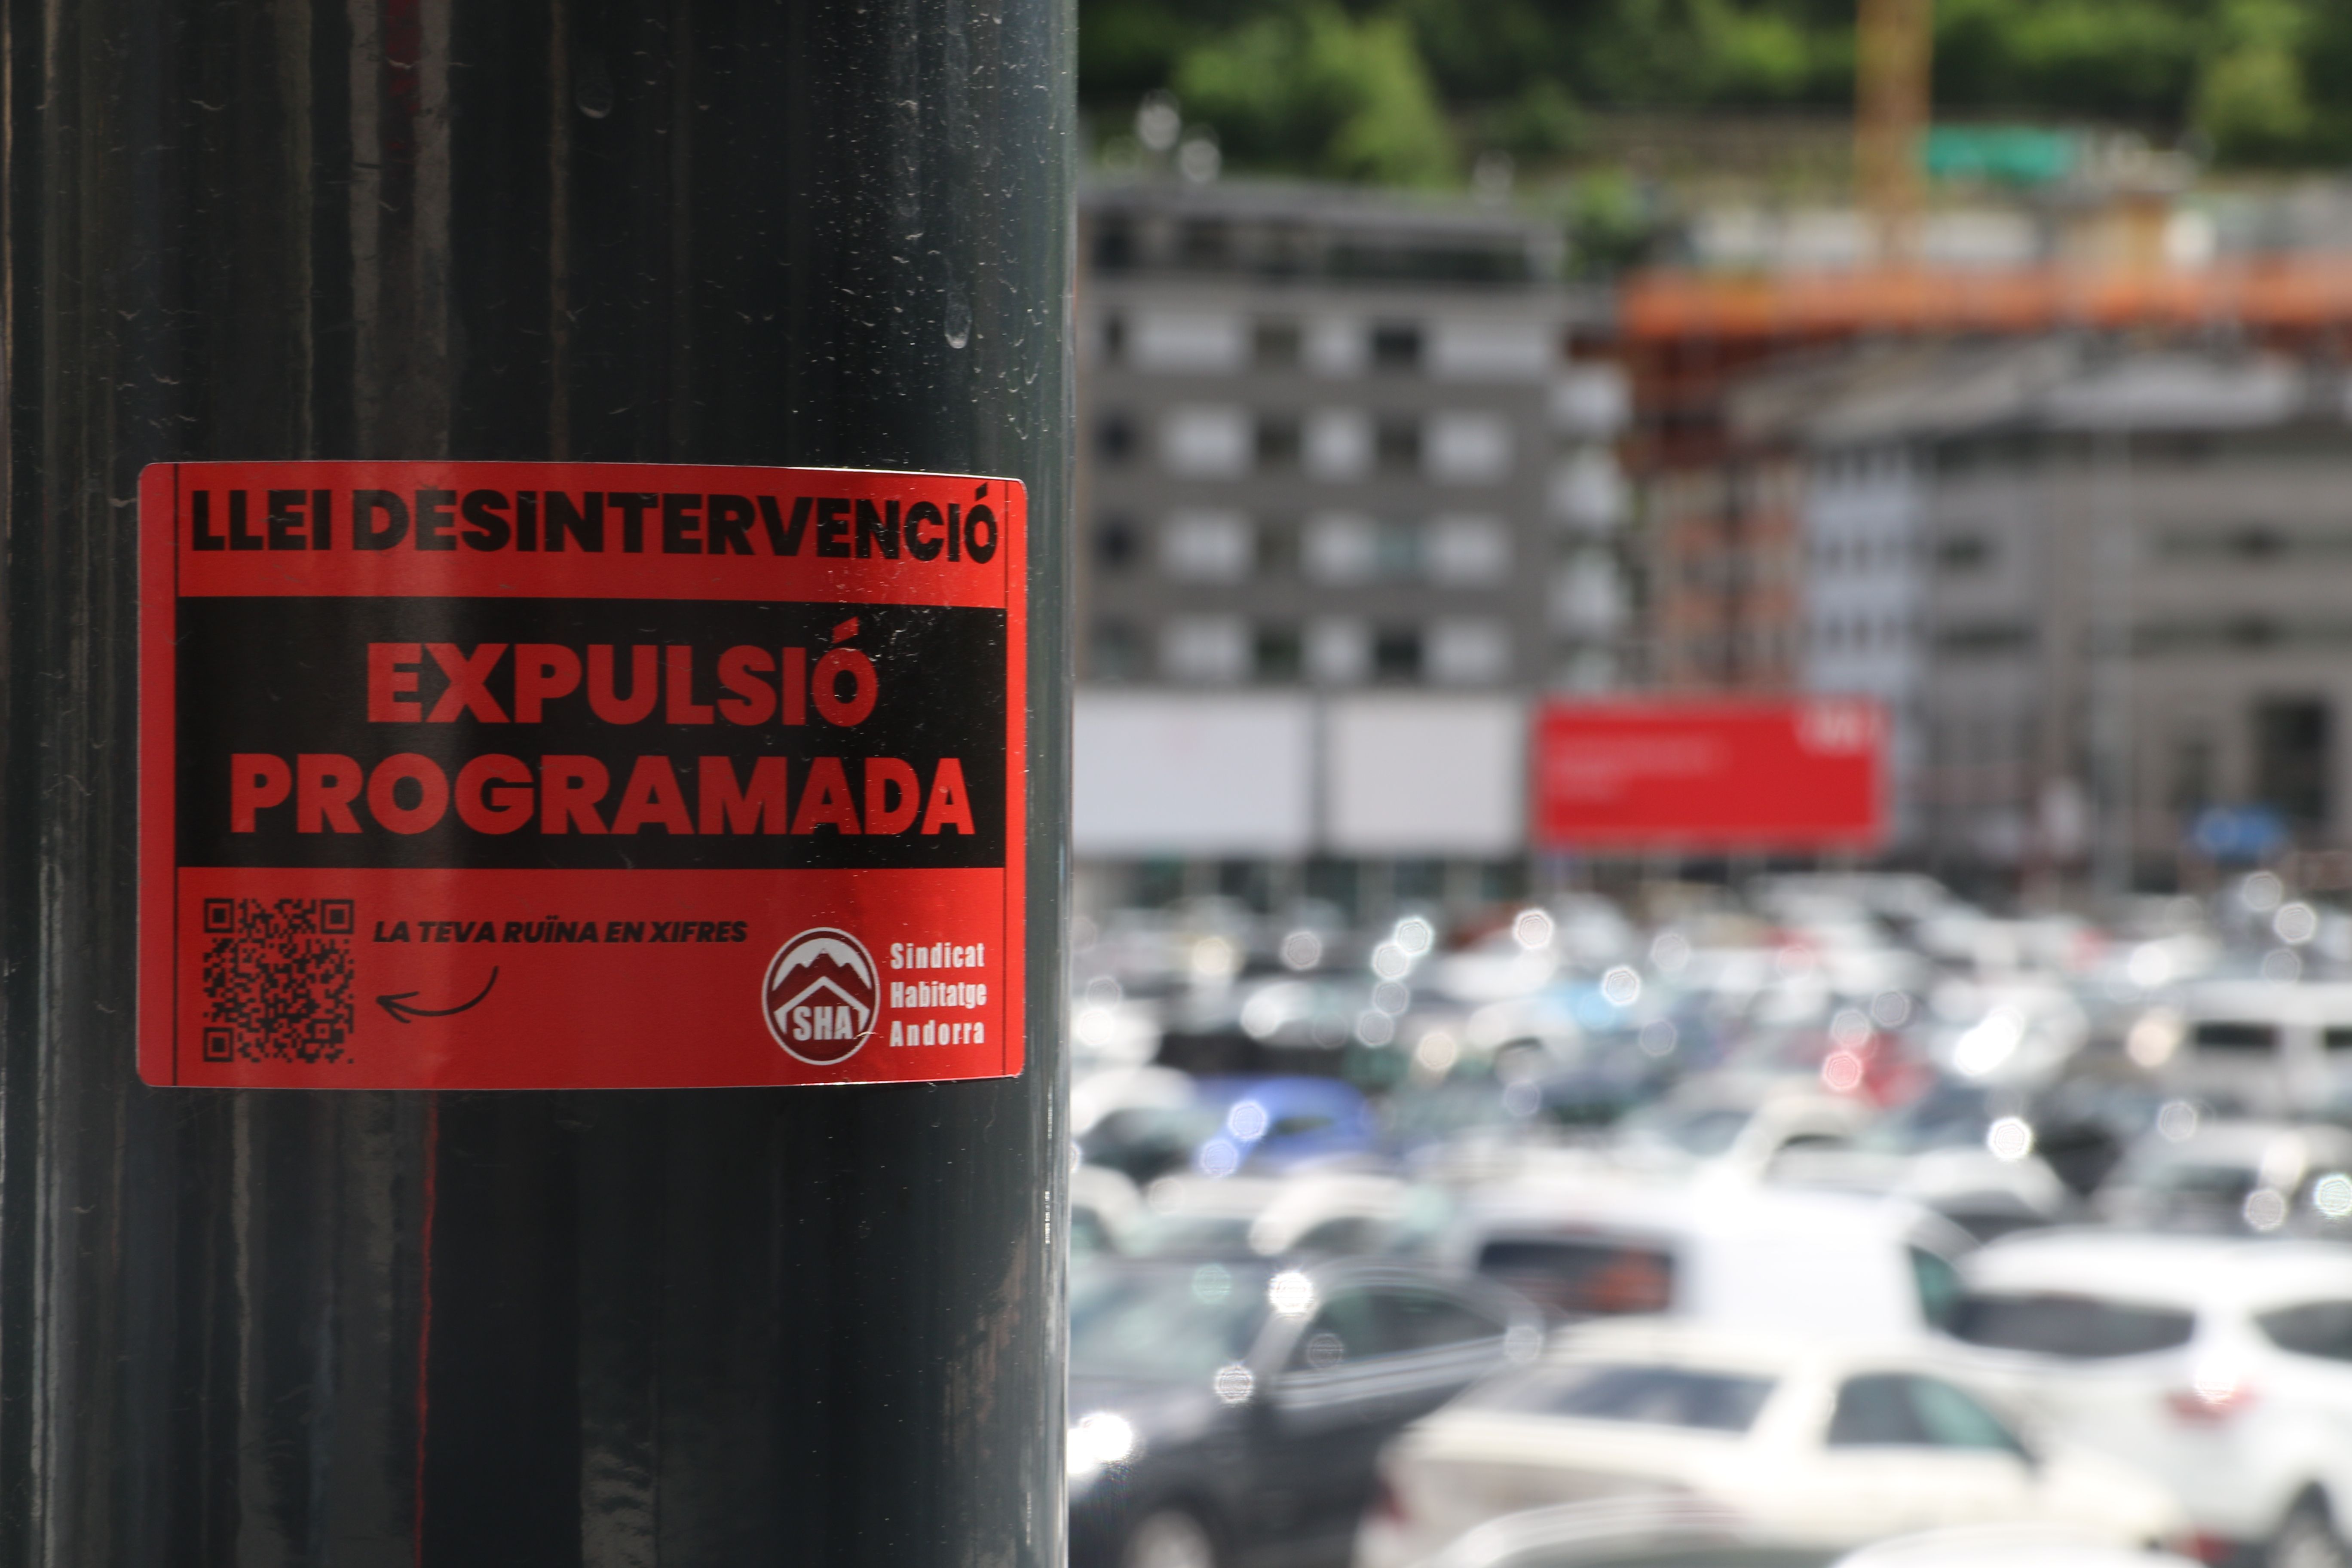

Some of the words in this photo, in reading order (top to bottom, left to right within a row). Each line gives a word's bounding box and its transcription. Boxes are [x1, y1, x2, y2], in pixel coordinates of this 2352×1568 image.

[192, 489, 331, 551] LLEI
[352, 482, 998, 564] DESINTERVENCIÓ
[368, 616, 878, 727] EXPULSIÓ
[230, 753, 976, 835] PROGRAMADA
[373, 920, 410, 943] LA
[417, 920, 496, 943] TEVA
[502, 915, 599, 943] RUÏNA
[605, 921, 645, 943] EN
[648, 920, 748, 943] XIFRES
[890, 942, 986, 969] Sindicat
[890, 980, 987, 1009] Habitatge
[793, 1005, 854, 1041] SHA
[889, 1020, 985, 1047] Andorra
